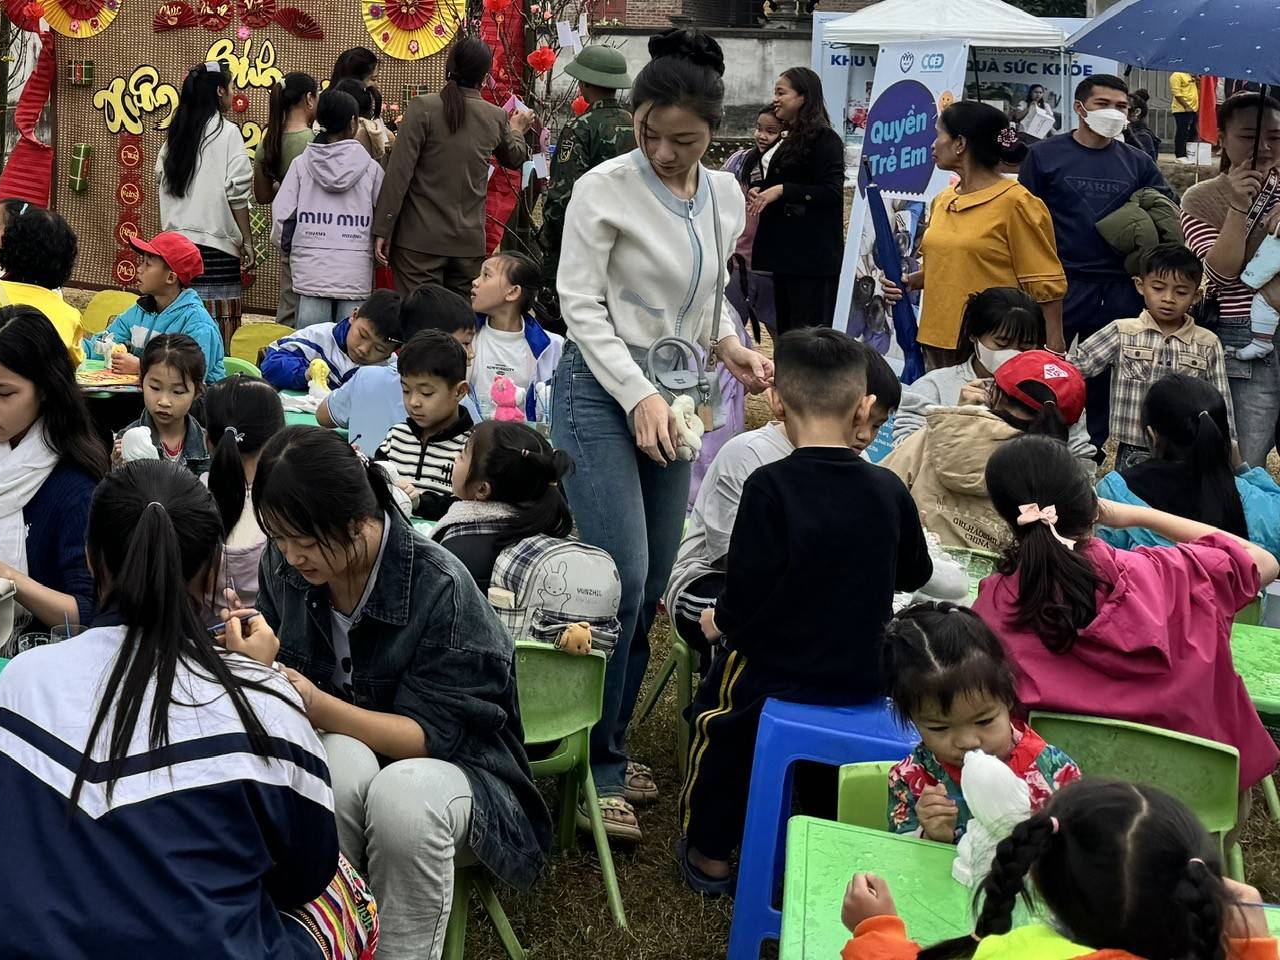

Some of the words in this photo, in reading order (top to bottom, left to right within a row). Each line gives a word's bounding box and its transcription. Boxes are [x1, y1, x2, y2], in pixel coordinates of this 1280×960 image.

[831, 55, 865, 67] KHU
[1003, 59, 1038, 74] SỨC
[870, 104, 927, 144] Quyền
[869, 147, 897, 176] Trẻ
[900, 146, 927, 169] Em
[1078, 181, 1120, 192] PARIS
[964, 532, 990, 549] CHINA
